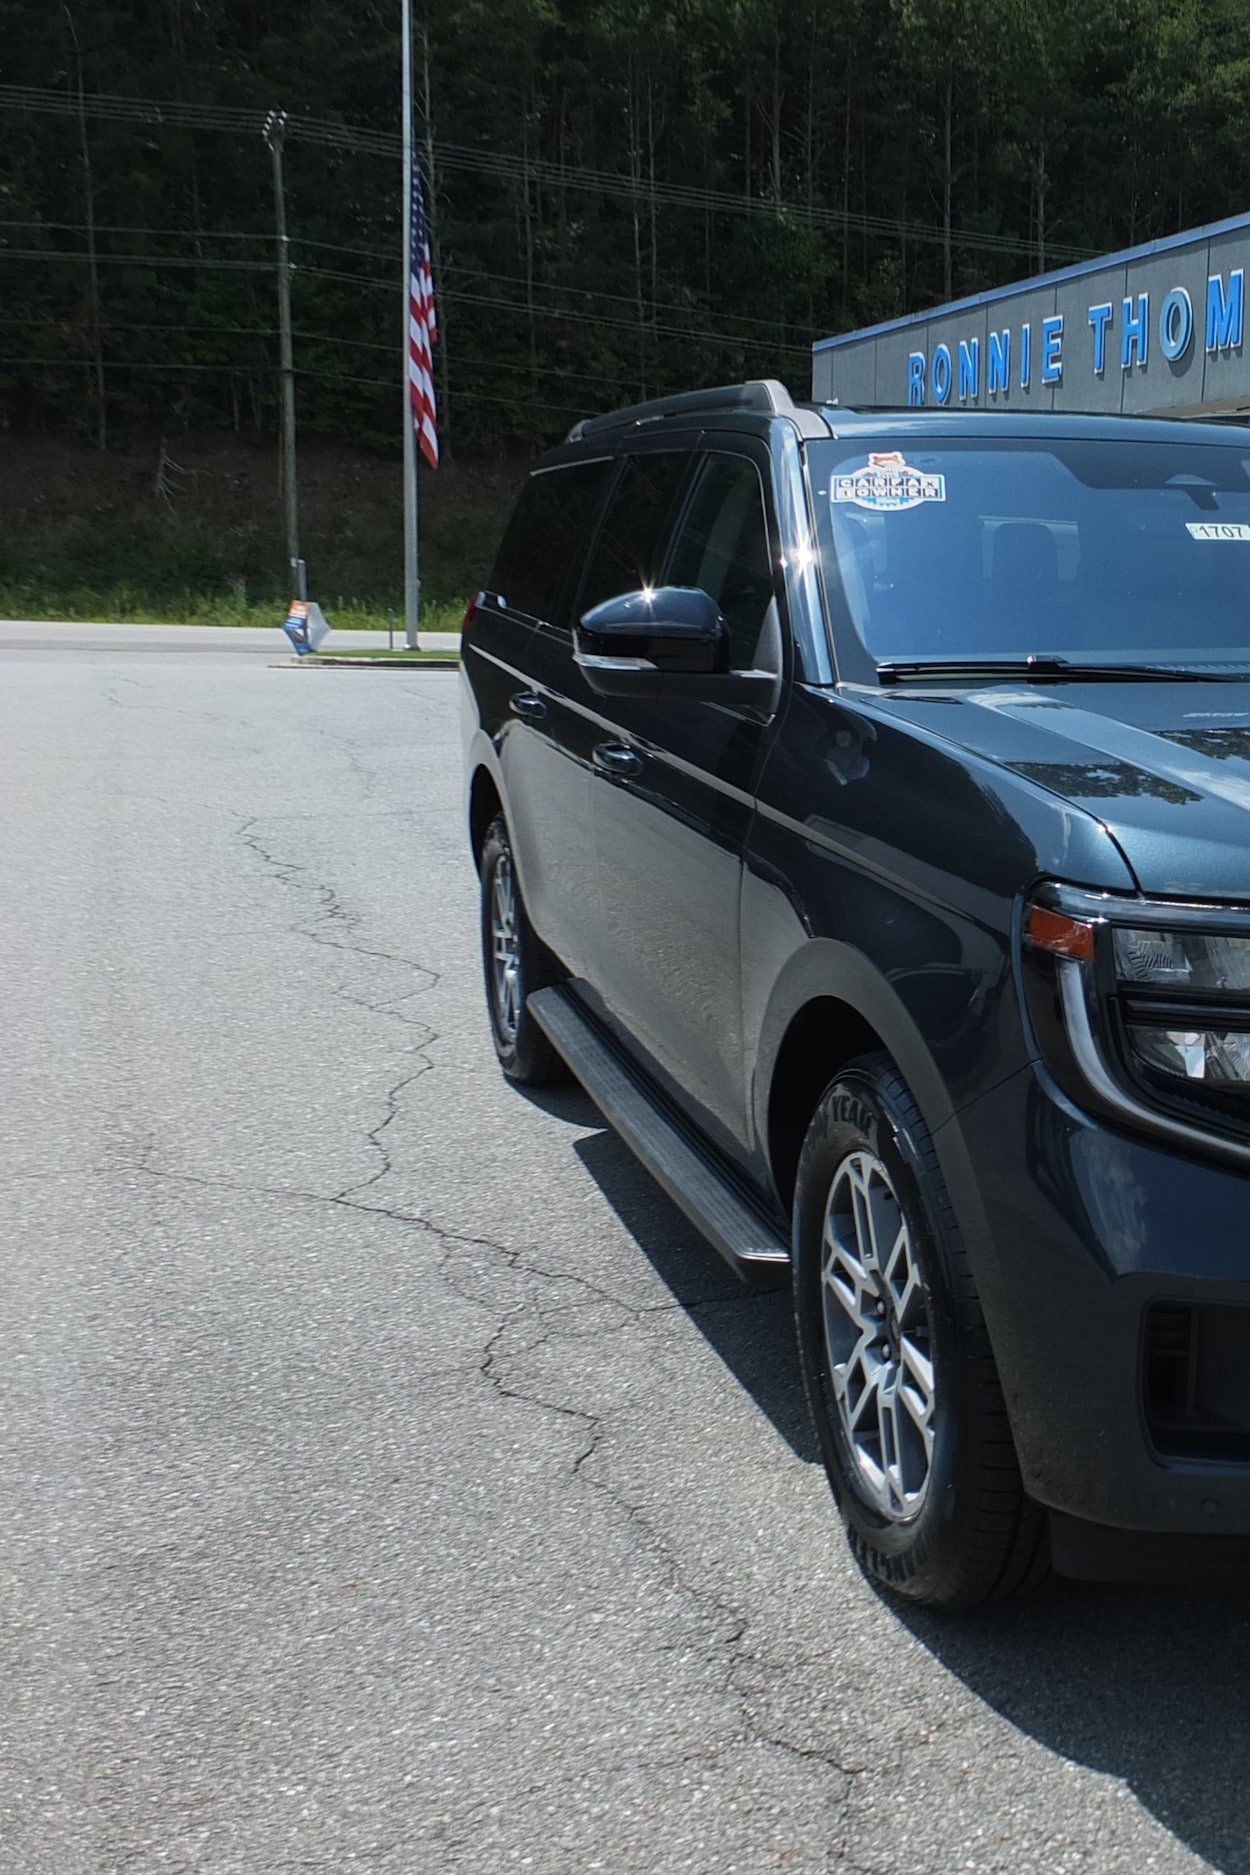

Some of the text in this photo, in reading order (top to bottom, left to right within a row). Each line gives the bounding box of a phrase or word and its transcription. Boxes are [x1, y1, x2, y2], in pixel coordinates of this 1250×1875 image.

[907, 314, 1064, 407] RONNIE
[837, 477, 939, 488] CARFAX
[1198, 525, 1244, 538] 1707
